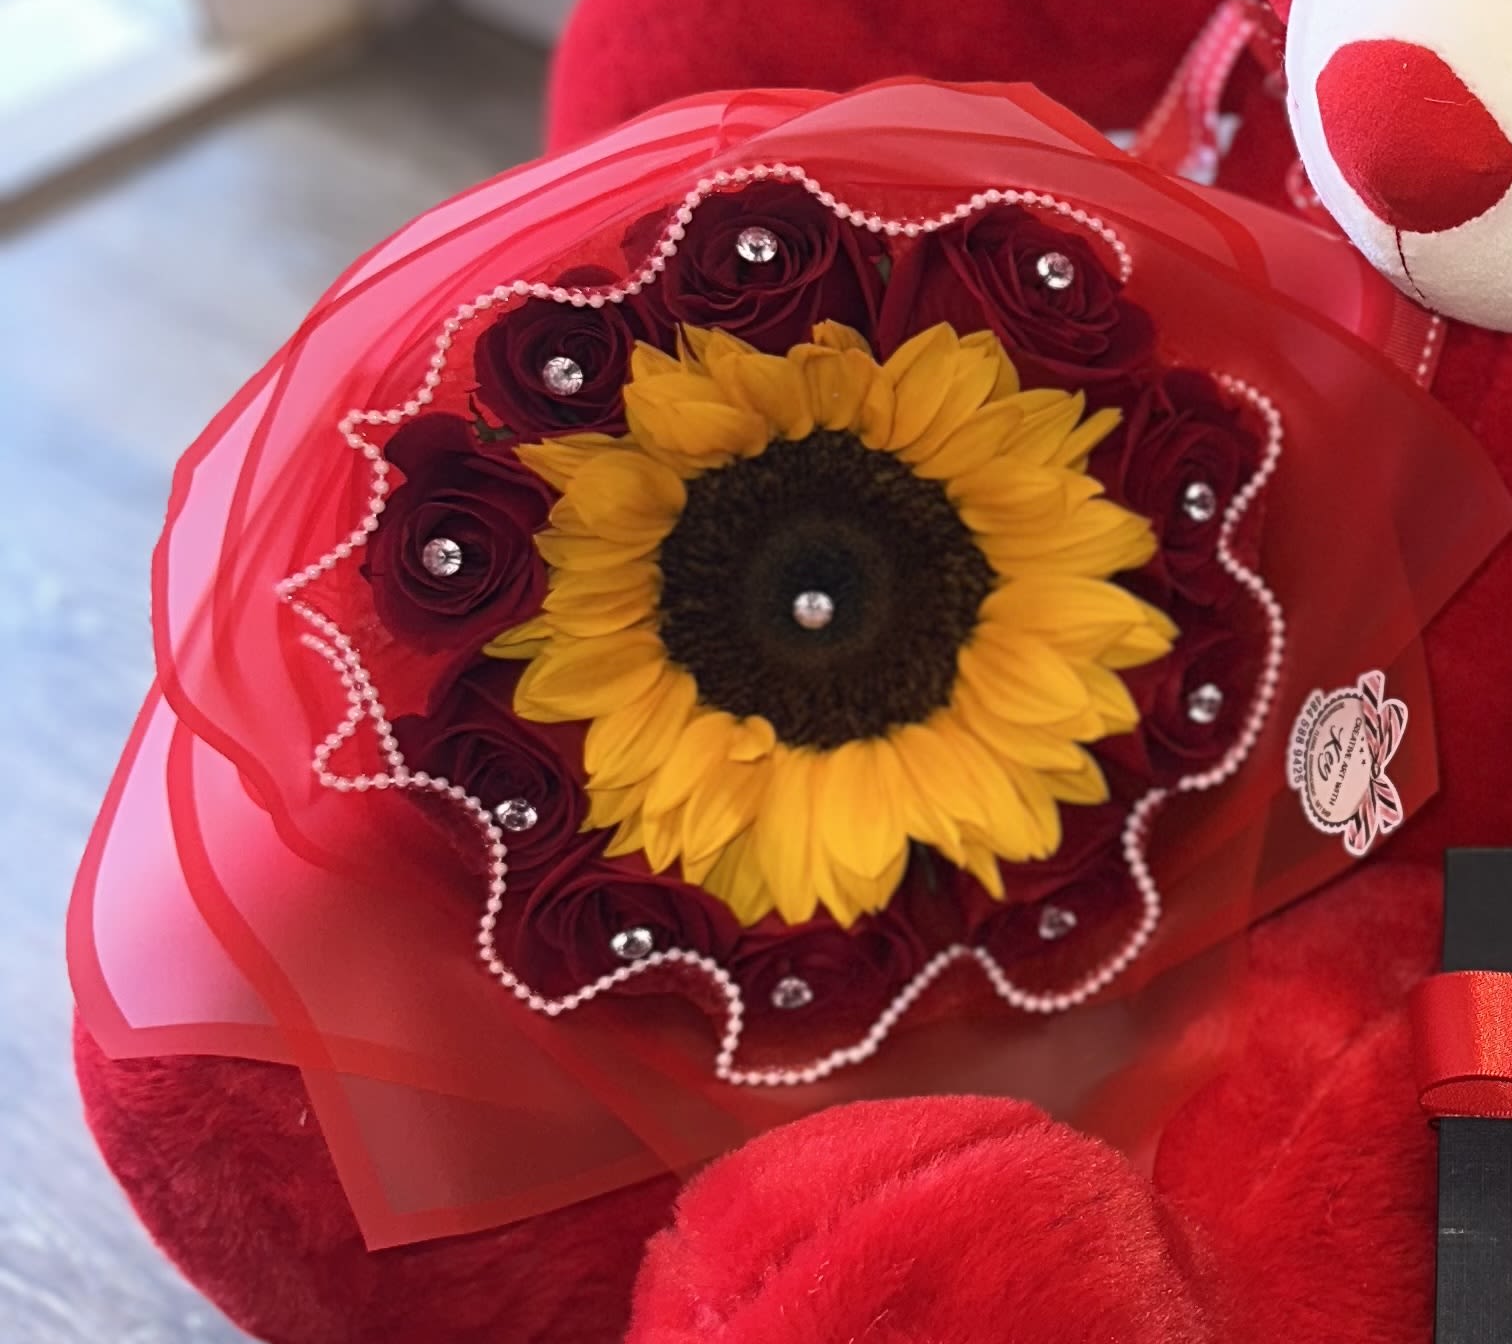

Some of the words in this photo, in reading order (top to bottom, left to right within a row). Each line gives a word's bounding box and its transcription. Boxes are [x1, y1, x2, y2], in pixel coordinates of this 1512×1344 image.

[1344, 717, 1362, 759] CREATIVE
[1338, 761, 1349, 781] ART
[1328, 781, 1342, 807] WITH
